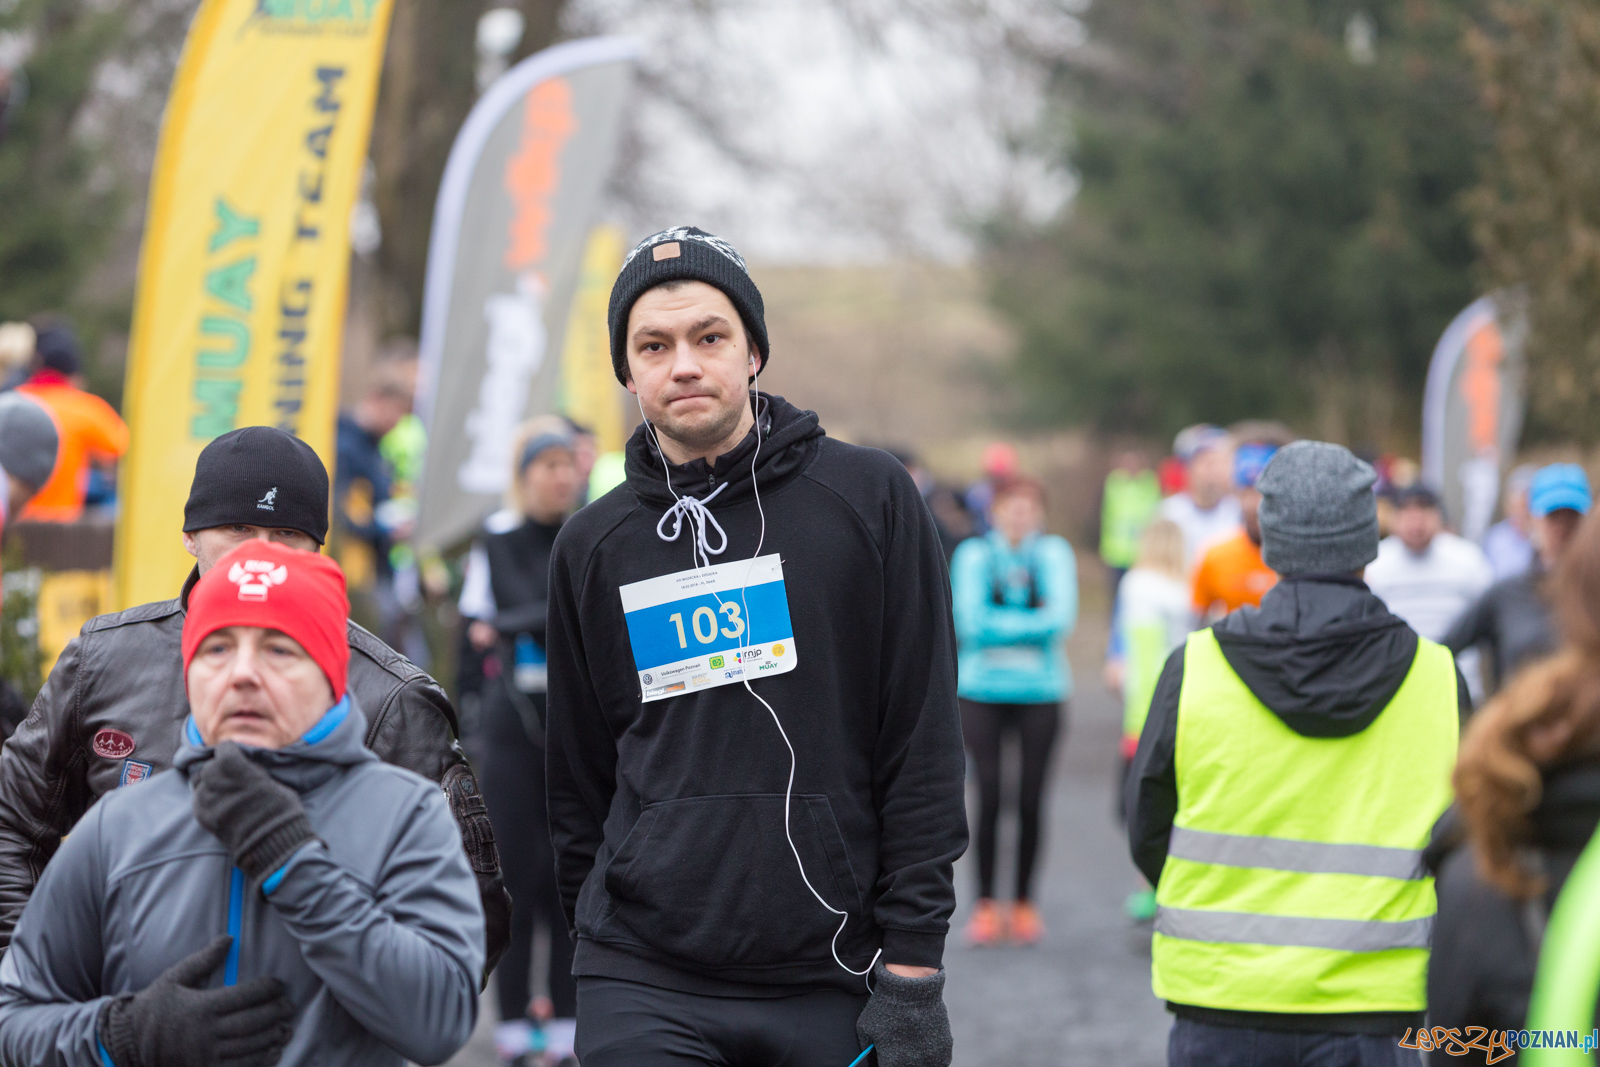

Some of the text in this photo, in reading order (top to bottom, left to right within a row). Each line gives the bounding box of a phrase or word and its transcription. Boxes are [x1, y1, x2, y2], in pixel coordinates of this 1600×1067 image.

[274, 277, 314, 435] NING
[296, 65, 346, 240] TEAM
[190, 197, 261, 439] MUAY
[669, 601, 745, 649] 103
[661, 666, 685, 677] Volkswagen
[685, 663, 701, 671] Poznań
[759, 662, 778, 671] MUAY
